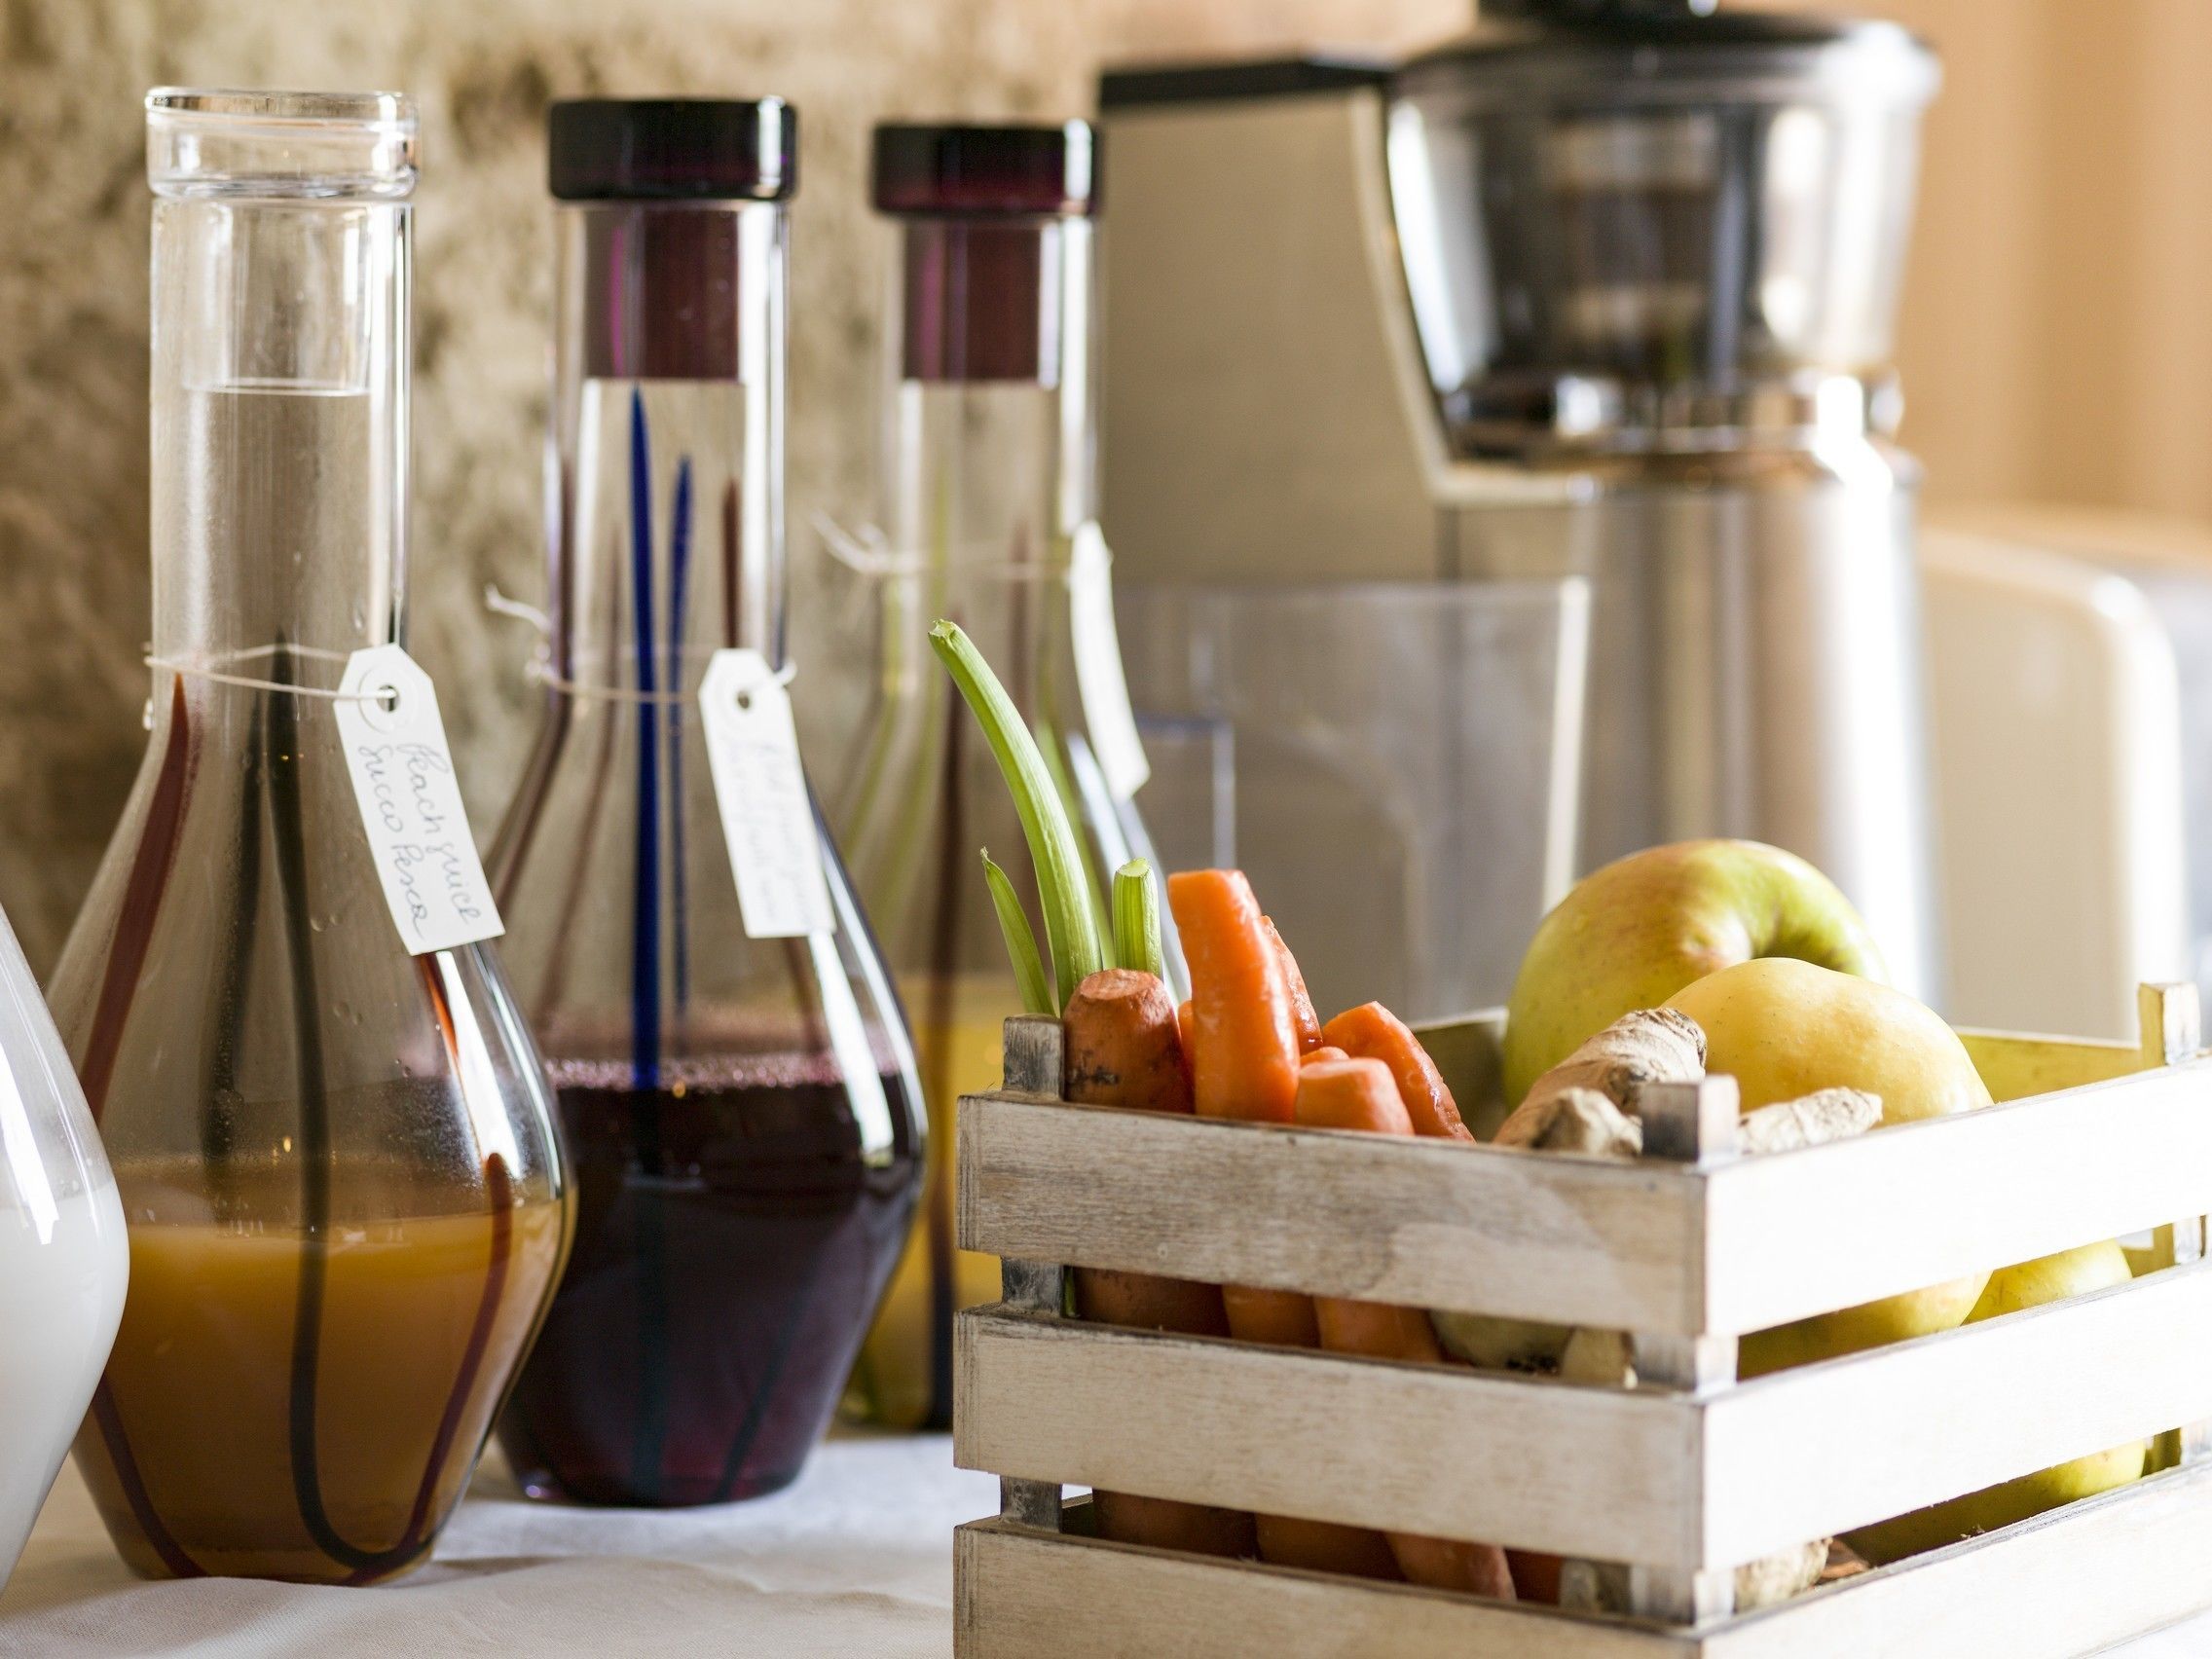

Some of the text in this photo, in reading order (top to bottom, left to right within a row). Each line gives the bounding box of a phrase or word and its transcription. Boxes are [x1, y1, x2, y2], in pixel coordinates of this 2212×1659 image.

[357, 744, 428, 940] Succo Pesca
[396, 743, 450, 834] Peach
